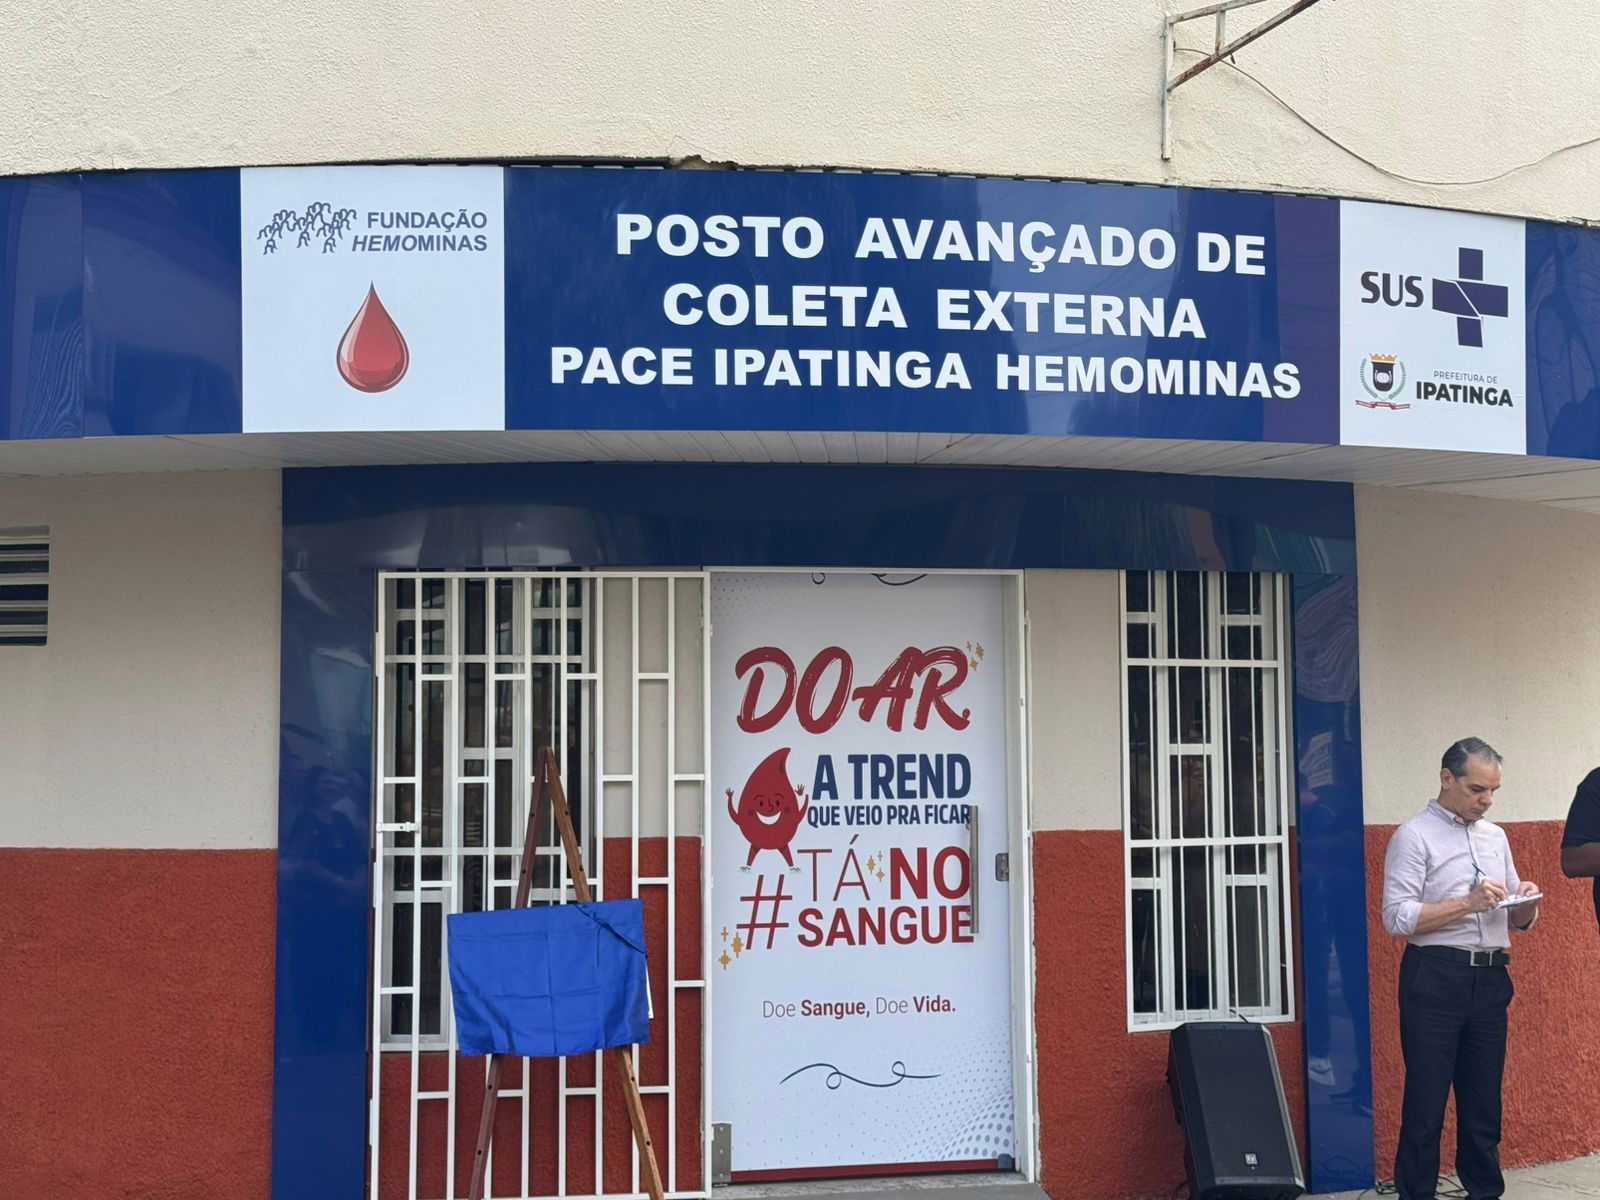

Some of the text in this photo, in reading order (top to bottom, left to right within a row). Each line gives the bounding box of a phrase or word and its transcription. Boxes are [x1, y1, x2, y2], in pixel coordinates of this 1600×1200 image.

[368, 209, 487, 232] FUNDAÇÃO
[352, 235, 487, 251] HEMOMINAS
[618, 214, 1265, 275] POSTO AVANÇADO DE
[1360, 270, 1425, 309] SUS
[664, 284, 1206, 338] COLETA EXTERNA
[552, 347, 1300, 398] PACE IPATINGA HEMOMINAS
[1433, 370, 1499, 385] PREFEITURA DE
[1416, 380, 1514, 408] IPATINGA
[735, 645, 971, 734] DOAR
[812, 754, 971, 800] A TREND
[807, 804, 971, 828] QUE VEIO PRA FICAR
[796, 833, 871, 902] TÁ
[890, 846, 970, 900] NO
[798, 904, 975, 947] SANGUE
[763, 995, 955, 1019] Doe Sangue, Doe Vida.
